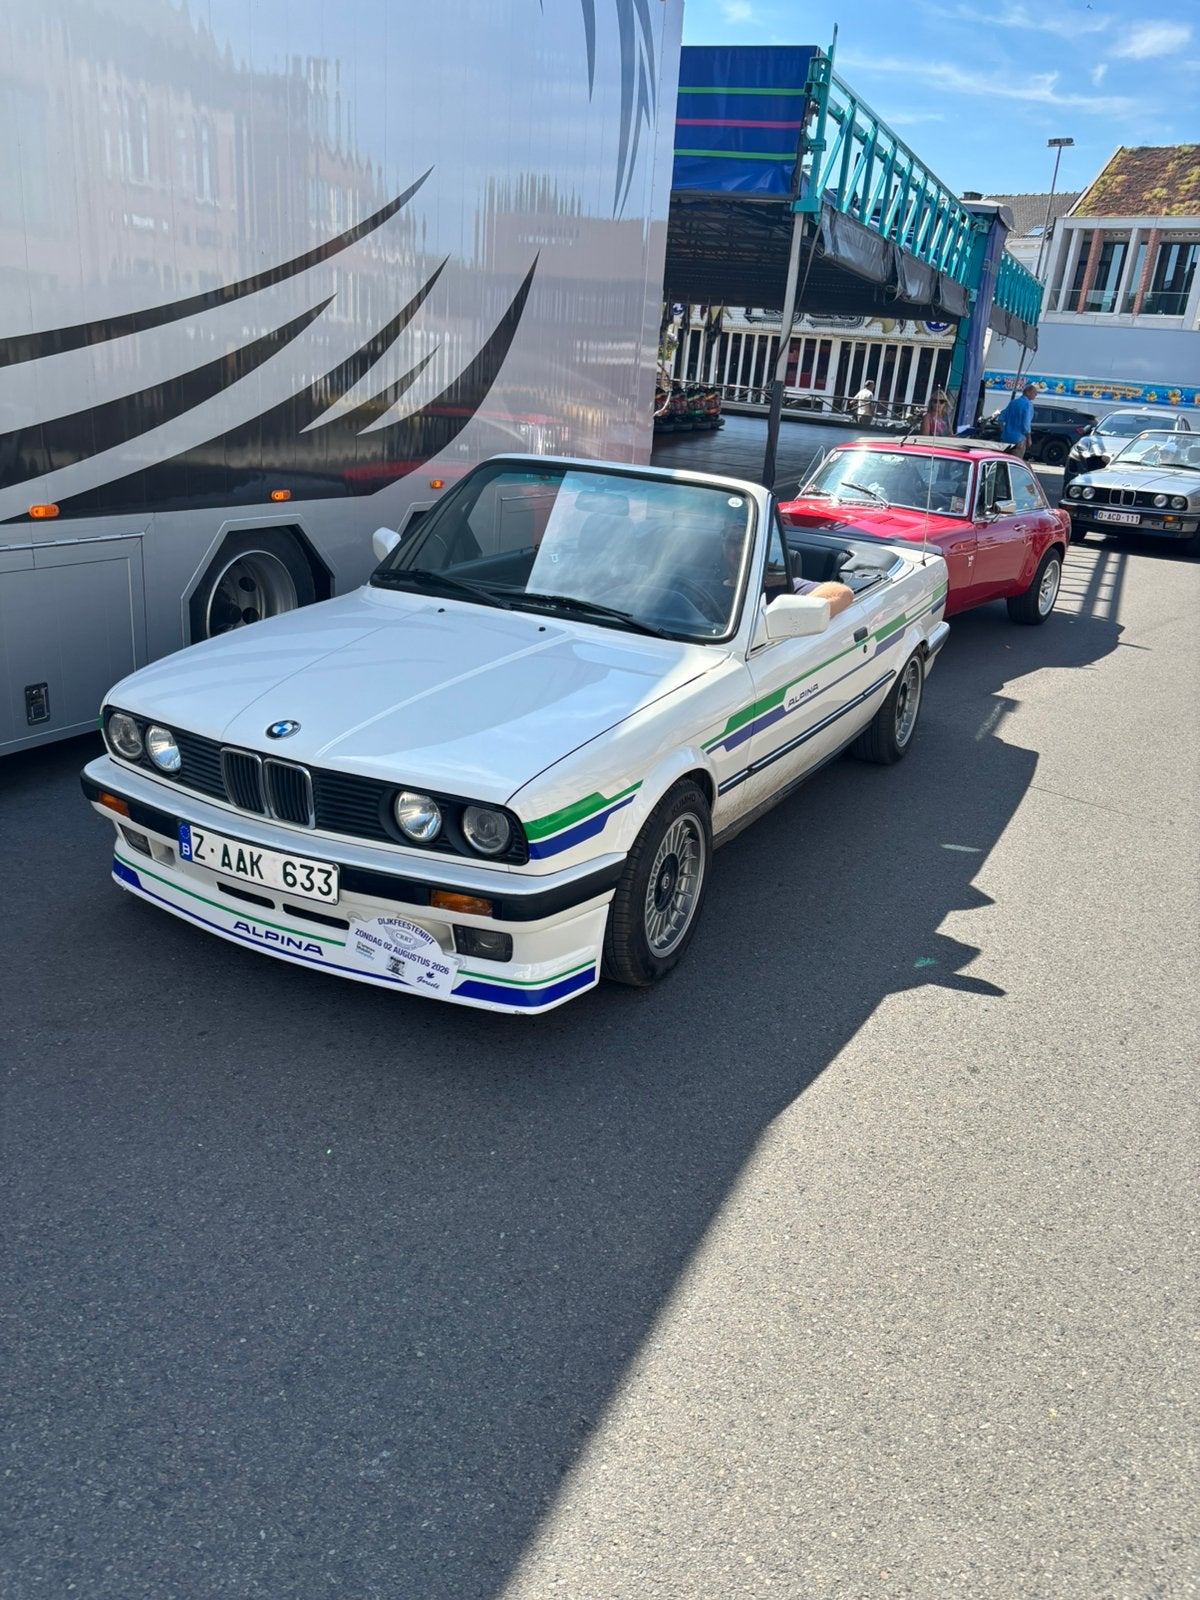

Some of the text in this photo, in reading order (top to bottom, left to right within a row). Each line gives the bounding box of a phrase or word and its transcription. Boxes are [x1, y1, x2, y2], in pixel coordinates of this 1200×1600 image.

[787, 683, 819, 708] ALPINA
[182, 842, 190, 856] B
[282, 860, 333, 897] 633
[233, 920, 324, 956] ALPINA
[377, 917, 435, 945] DIJKFEESTENRIT
[354, 928, 383, 947] ZONDAG
[383, 942, 393, 951] 02
[392, 946, 431, 968] AUGUSTUS
[431, 961, 450, 975] 2026
